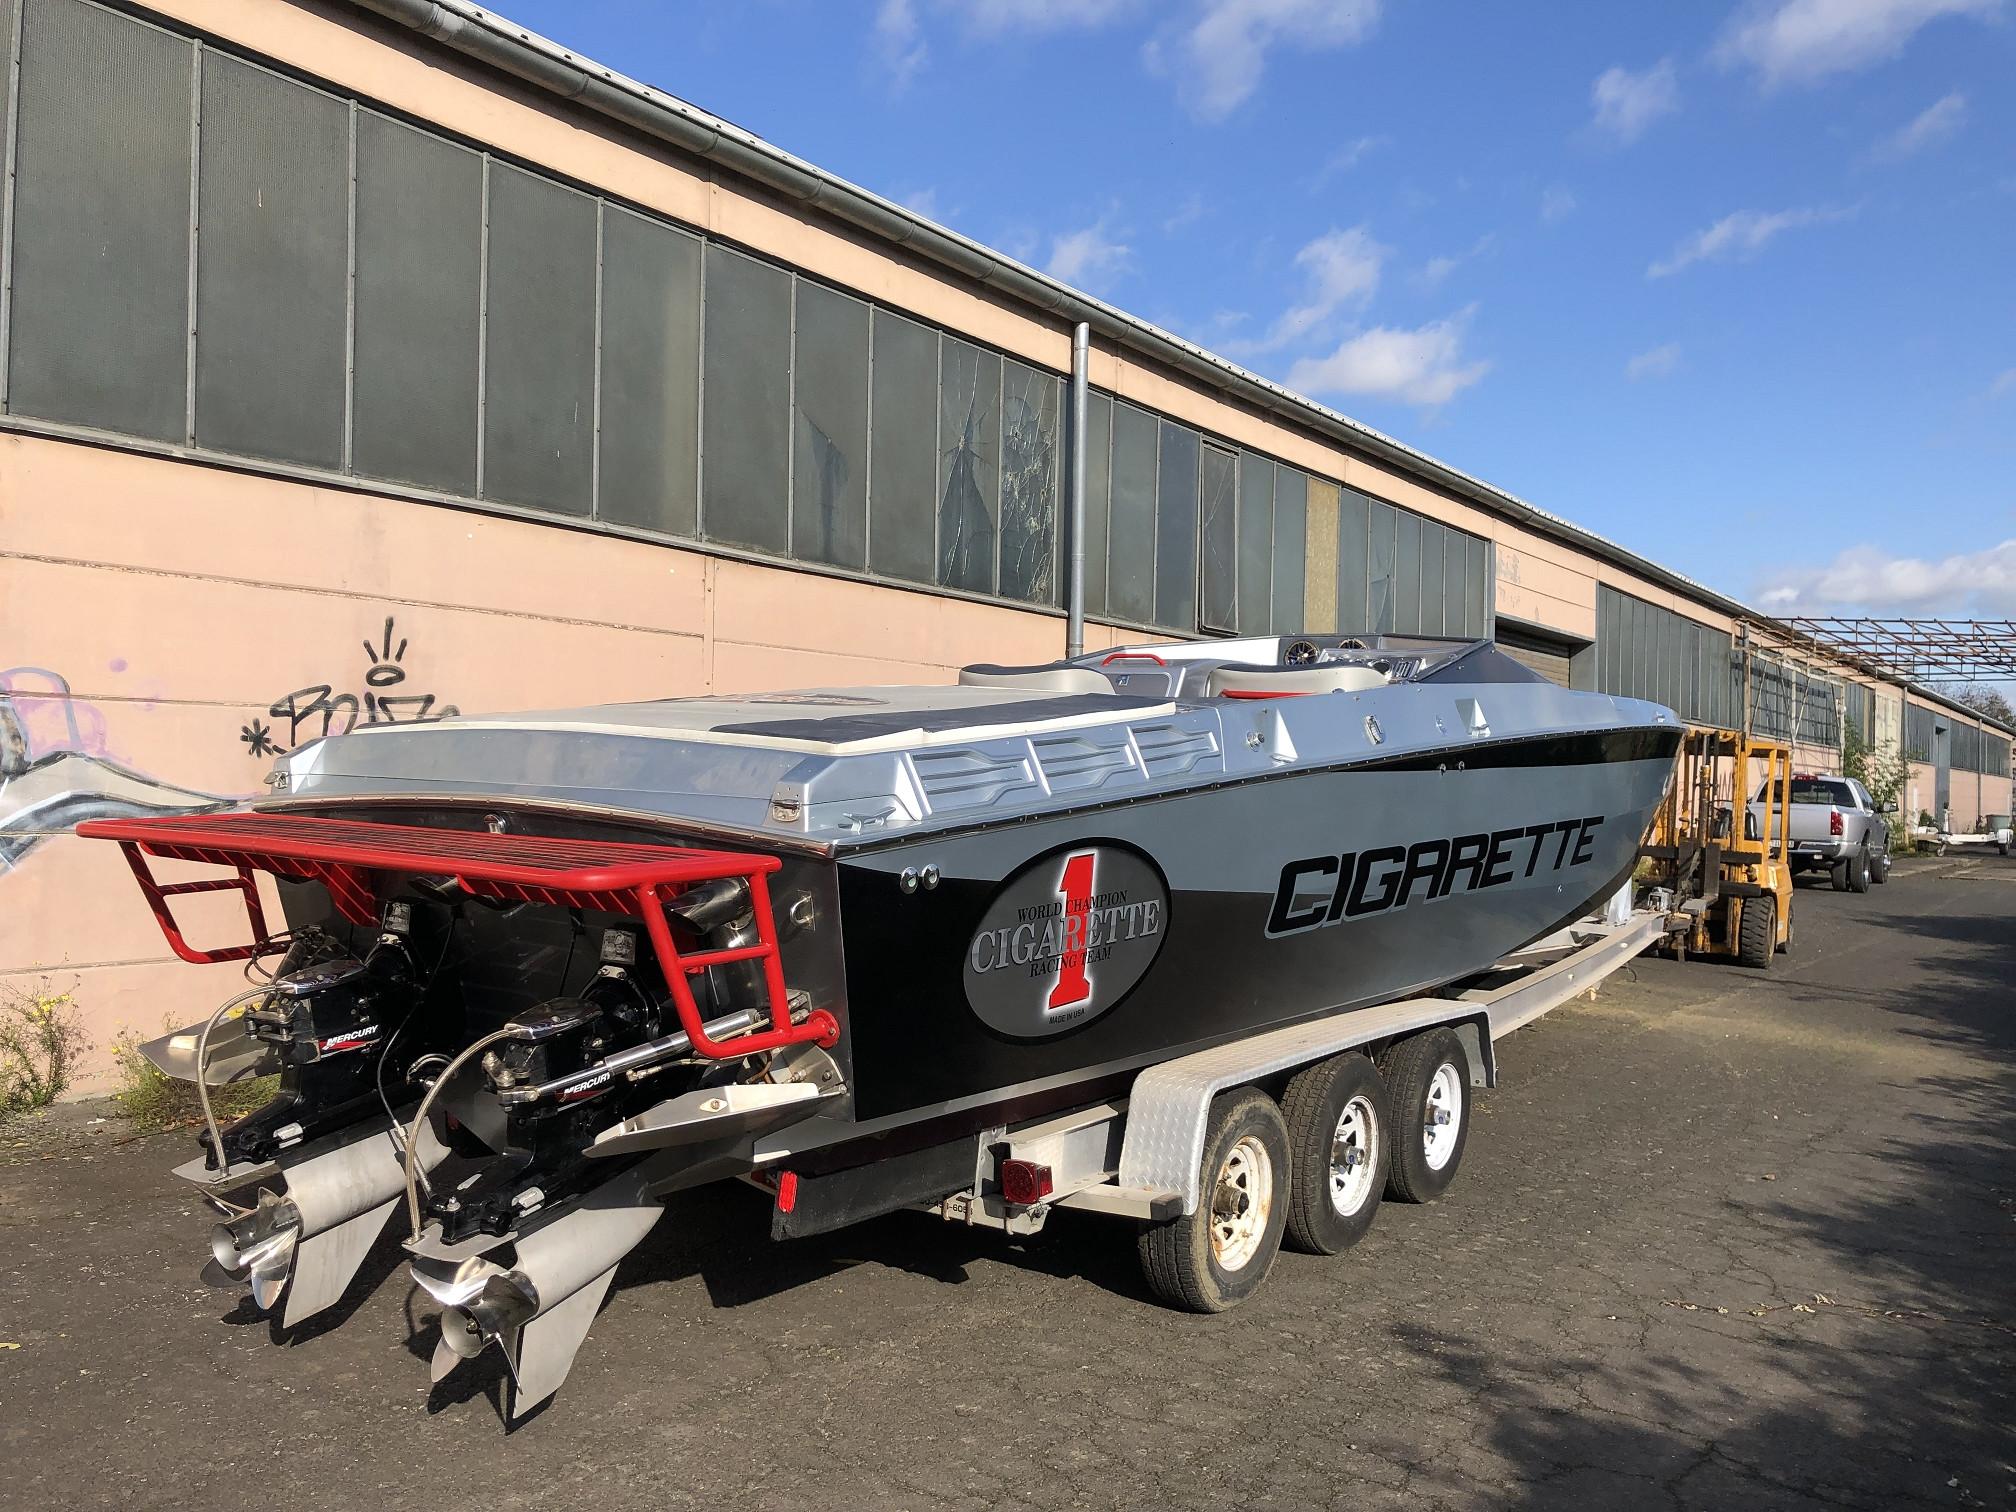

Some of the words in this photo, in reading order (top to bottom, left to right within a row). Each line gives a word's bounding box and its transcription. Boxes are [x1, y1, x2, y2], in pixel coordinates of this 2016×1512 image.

[1265, 815, 1605, 937] CIGARETTE
[1018, 902, 1063, 922] WORLD
[1065, 889, 1128, 915] CHAMPION
[971, 899, 1161, 974] CIGARETTE
[1047, 851, 1095, 1011] 1
[1029, 953, 1078, 978] RACING
[1080, 946, 1112, 967] TEAM
[1073, 1008, 1085, 1018] USA
[324, 1024, 379, 1049] MERCURY
